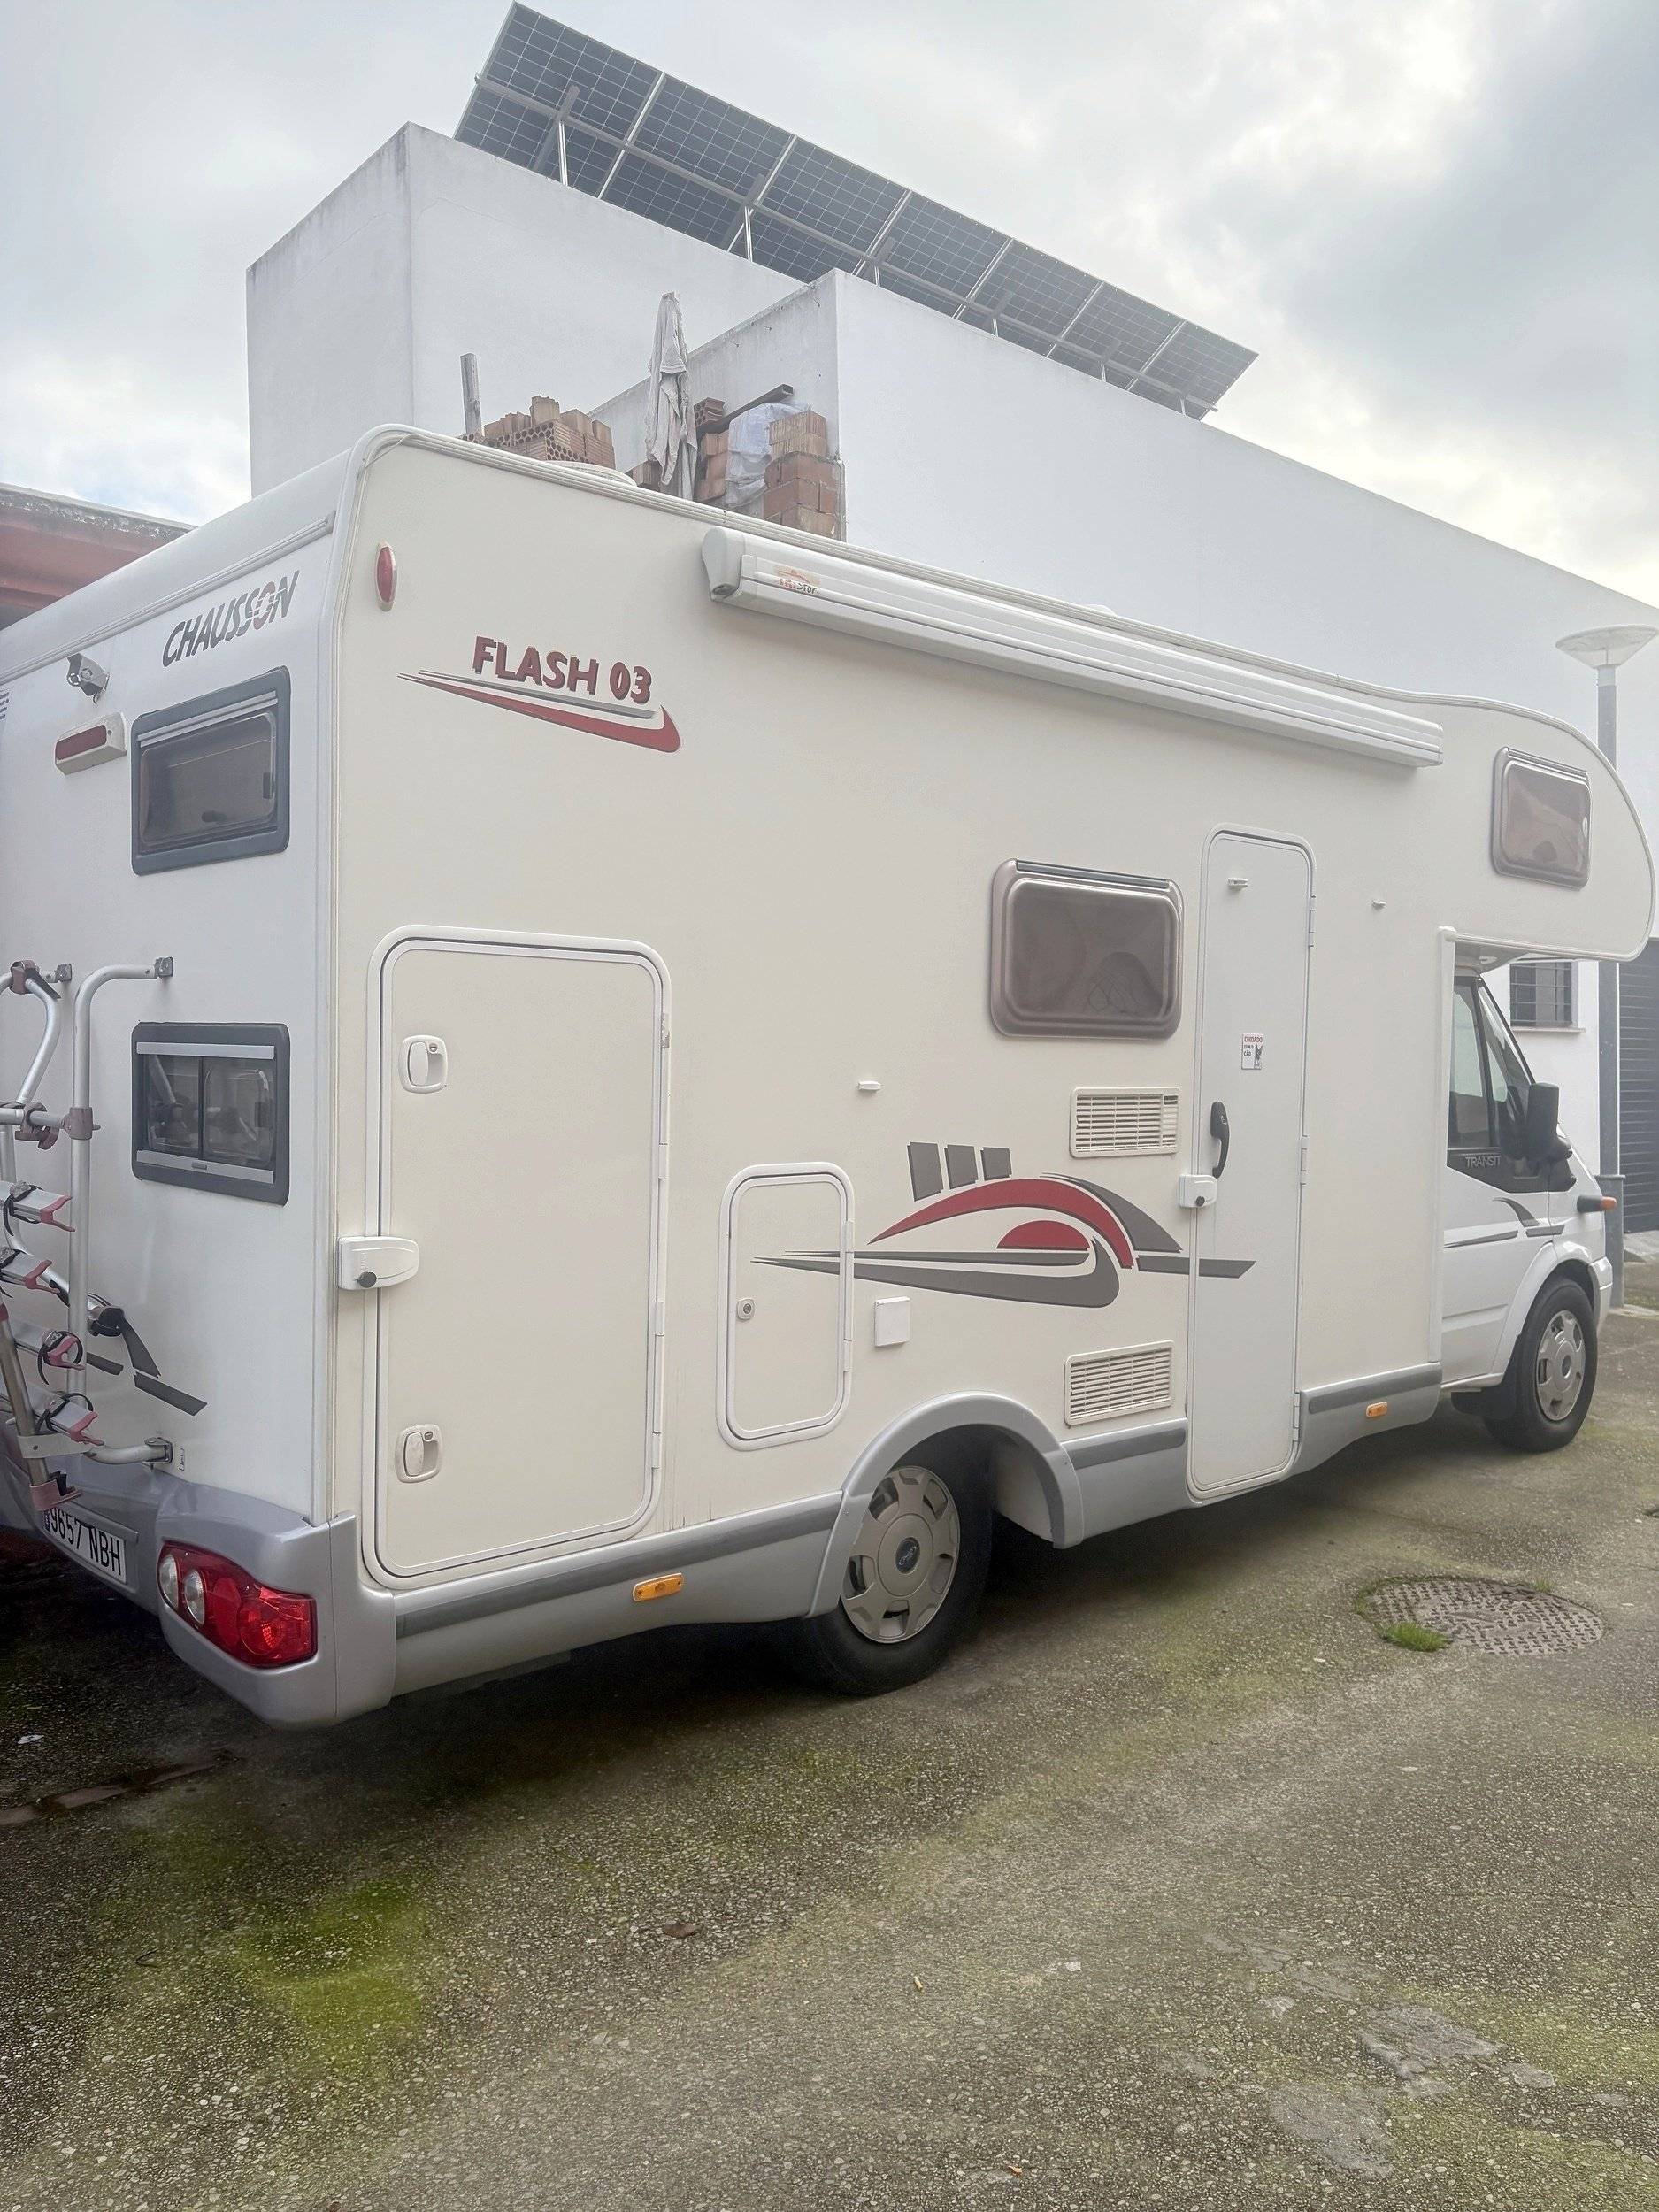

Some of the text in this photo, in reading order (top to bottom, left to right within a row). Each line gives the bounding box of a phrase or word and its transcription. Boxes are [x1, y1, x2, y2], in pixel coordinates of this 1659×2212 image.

[162, 569, 300, 667] CHAUSSON
[472, 635, 652, 704] FLASH 03
[1465, 1156, 1501, 1168] TRANSIT
[50, 1507, 122, 1576] 9657 NBH
